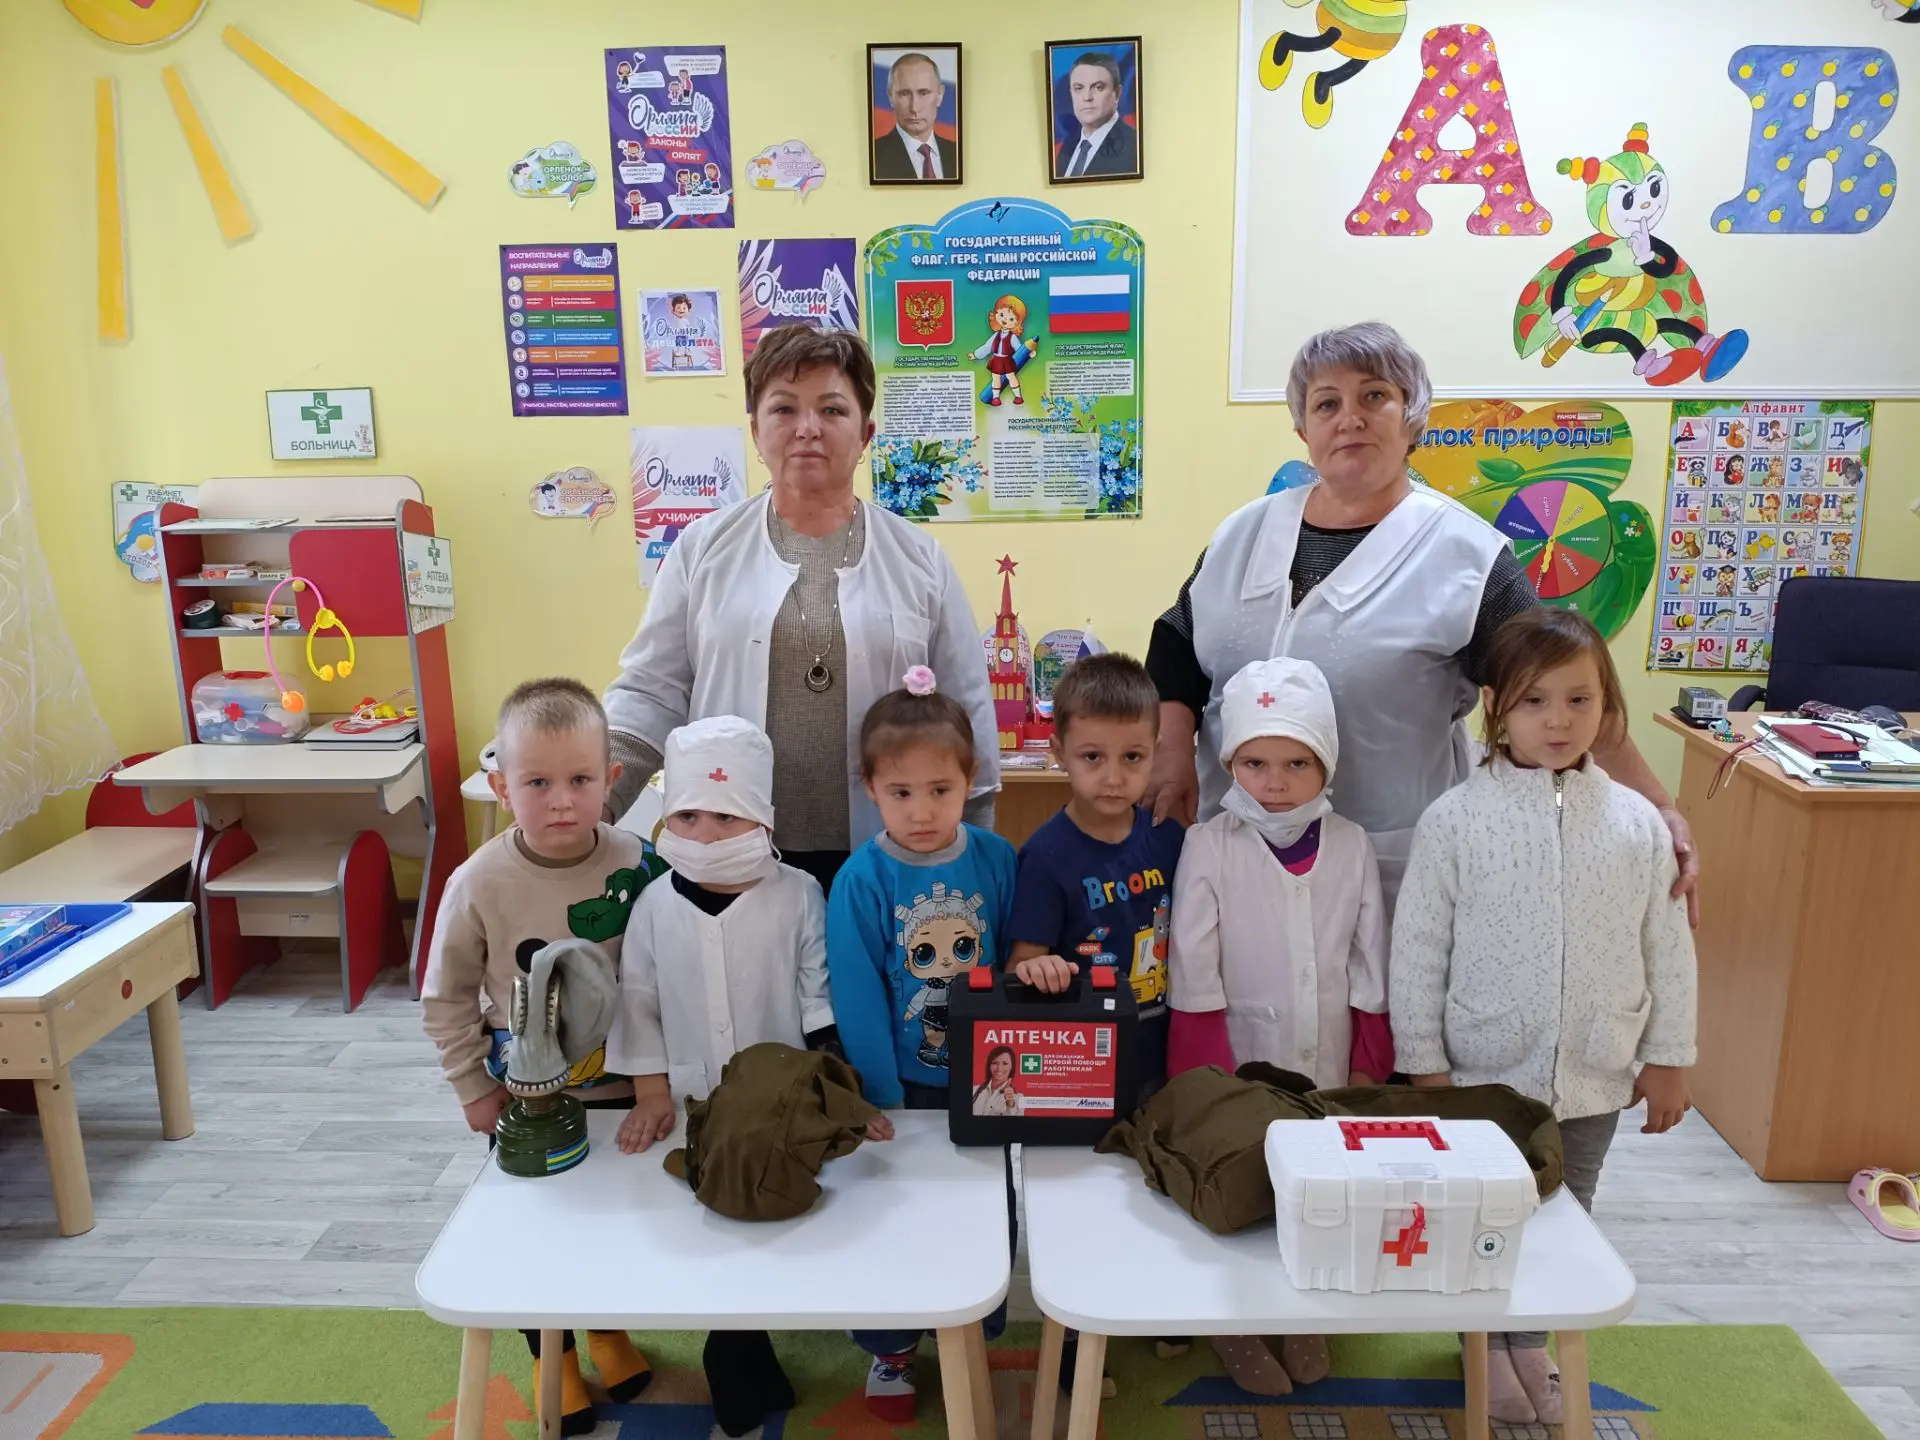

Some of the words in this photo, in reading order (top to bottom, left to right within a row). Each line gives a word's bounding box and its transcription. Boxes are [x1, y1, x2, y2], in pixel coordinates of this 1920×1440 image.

[629, 95, 699, 131] Орлята
[649, 138, 687, 148] ЗАКОНЫ
[671, 151, 702, 161] ОРЛЯТ
[550, 174, 583, 182] ЭКОЛОГ
[945, 231, 1062, 248] ГОСУДАРСТВЕННЫЙ
[508, 251, 571, 260] ВОСПИТАТЕЛЬНЫЕ
[985, 251, 1018, 265] ГИМН
[1020, 247, 1097, 263] РОССИЙСКОЙ
[510, 262, 559, 270] НАПРАВЛЕНИЯ
[967, 268, 1041, 283] ФЕДЕРАЦИИ
[755, 273, 828, 309] Орлята
[655, 318, 699, 337] Орлята
[1741, 402, 1806, 416] Алфавит
[1681, 421, 1694, 437] А
[1718, 422, 1730, 437] Б
[1757, 422, 1769, 437] В
[1794, 422, 1806, 437] Г
[1830, 422, 1846, 439] Д
[290, 440, 357, 452] БОЛЬНИЦА
[1484, 427, 1613, 452] природы
[1677, 456, 1688, 472] Е
[1750, 457, 1769, 472] Ж
[1790, 457, 1802, 472] З
[1827, 457, 1842, 472] И
[645, 456, 717, 491] Орлята
[146, 495, 185, 504] ПЕДИАТРА
[147, 489, 182, 497] КАБИНЕТ
[1711, 493, 1723, 508] К
[1749, 493, 1765, 508] Л
[1786, 493, 1802, 508] М
[1823, 494, 1838, 509] Н
[657, 512, 704, 523] УЧИМС
[1507, 521, 1536, 535] вторник
[1671, 530, 1684, 545] О
[1707, 530, 1721, 545] П
[1747, 530, 1758, 545] Р
[1783, 530, 1795, 545] С
[1820, 531, 1832, 546] Т
[1561, 553, 1579, 576] суббота
[426, 570, 450, 583] АПТЕКА
[1668, 566, 1681, 581] У
[1702, 566, 1717, 581] Ф
[1742, 566, 1756, 582] Х
[1660, 637, 1673, 651] Э
[1697, 638, 1715, 652] Ю
[1735, 638, 1749, 653] Я
[1082, 868, 1165, 910] Broom
[1094, 954, 1113, 964] CITY
[984, 1029, 1087, 1045] АПТЕЧКА
